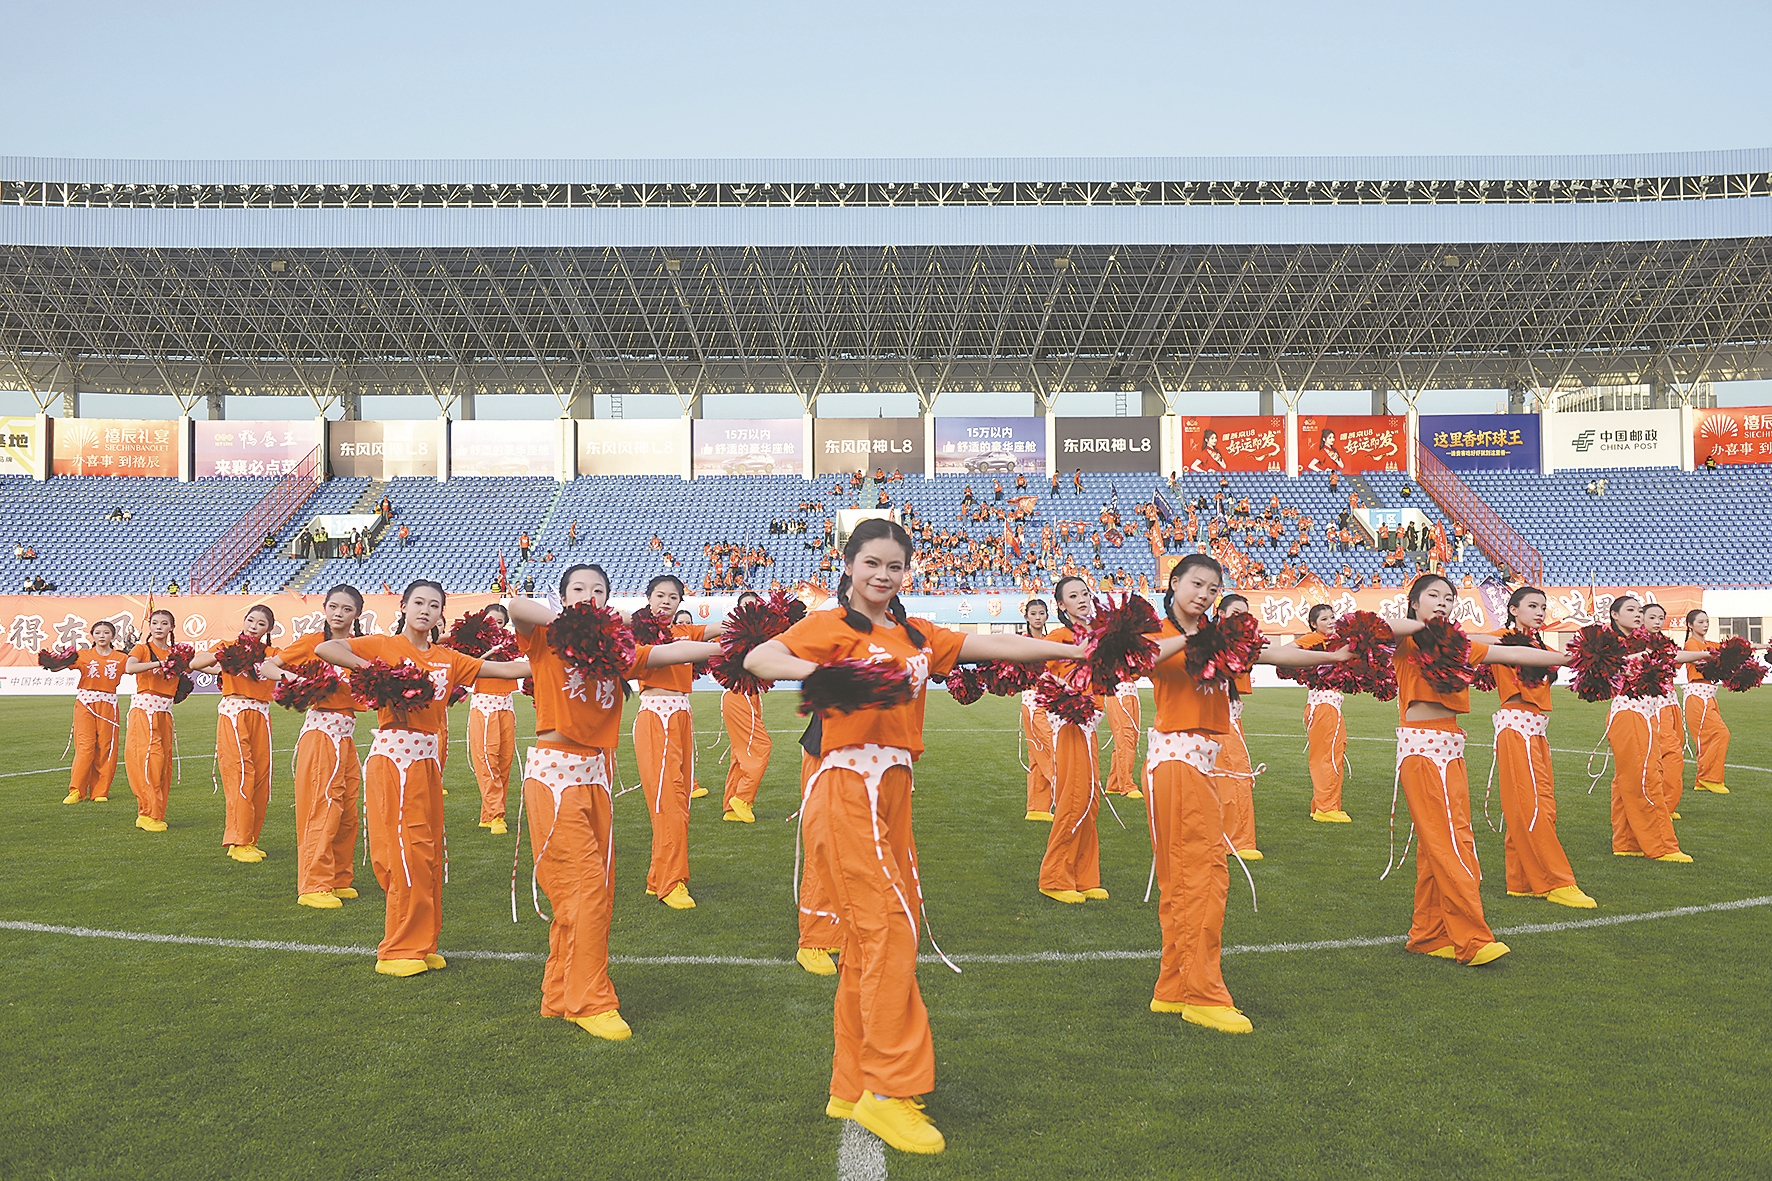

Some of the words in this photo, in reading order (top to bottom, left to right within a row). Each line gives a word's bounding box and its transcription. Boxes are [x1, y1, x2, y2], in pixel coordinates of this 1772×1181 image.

[104, 427, 170, 444] 禧辰礼宴
[724, 428, 771, 440] 15万以内
[966, 426, 1013, 439] 15万以内
[1433, 428, 1524, 448] 这里香虾球王
[1600, 429, 1658, 443] 中国邮政
[715, 442, 795, 455] 舒适的豪华座舱
[824, 439, 913, 455] 东风风神L8
[957, 440, 1037, 453] 舒适的豪华座舱
[1063, 437, 1152, 453] 东风风神L8
[1600, 443, 1631, 451] CHINA
[1634, 442, 1658, 450] POST
[1711, 442, 1754, 456] 办喜事
[71, 454, 114, 469] 办喜事
[118, 454, 160, 469] 到禧辰
[214, 458, 299, 476] 来襄必点菜
[0, 611, 140, 653] 得东风
[10, 676, 76, 686] 中国体育彩票
